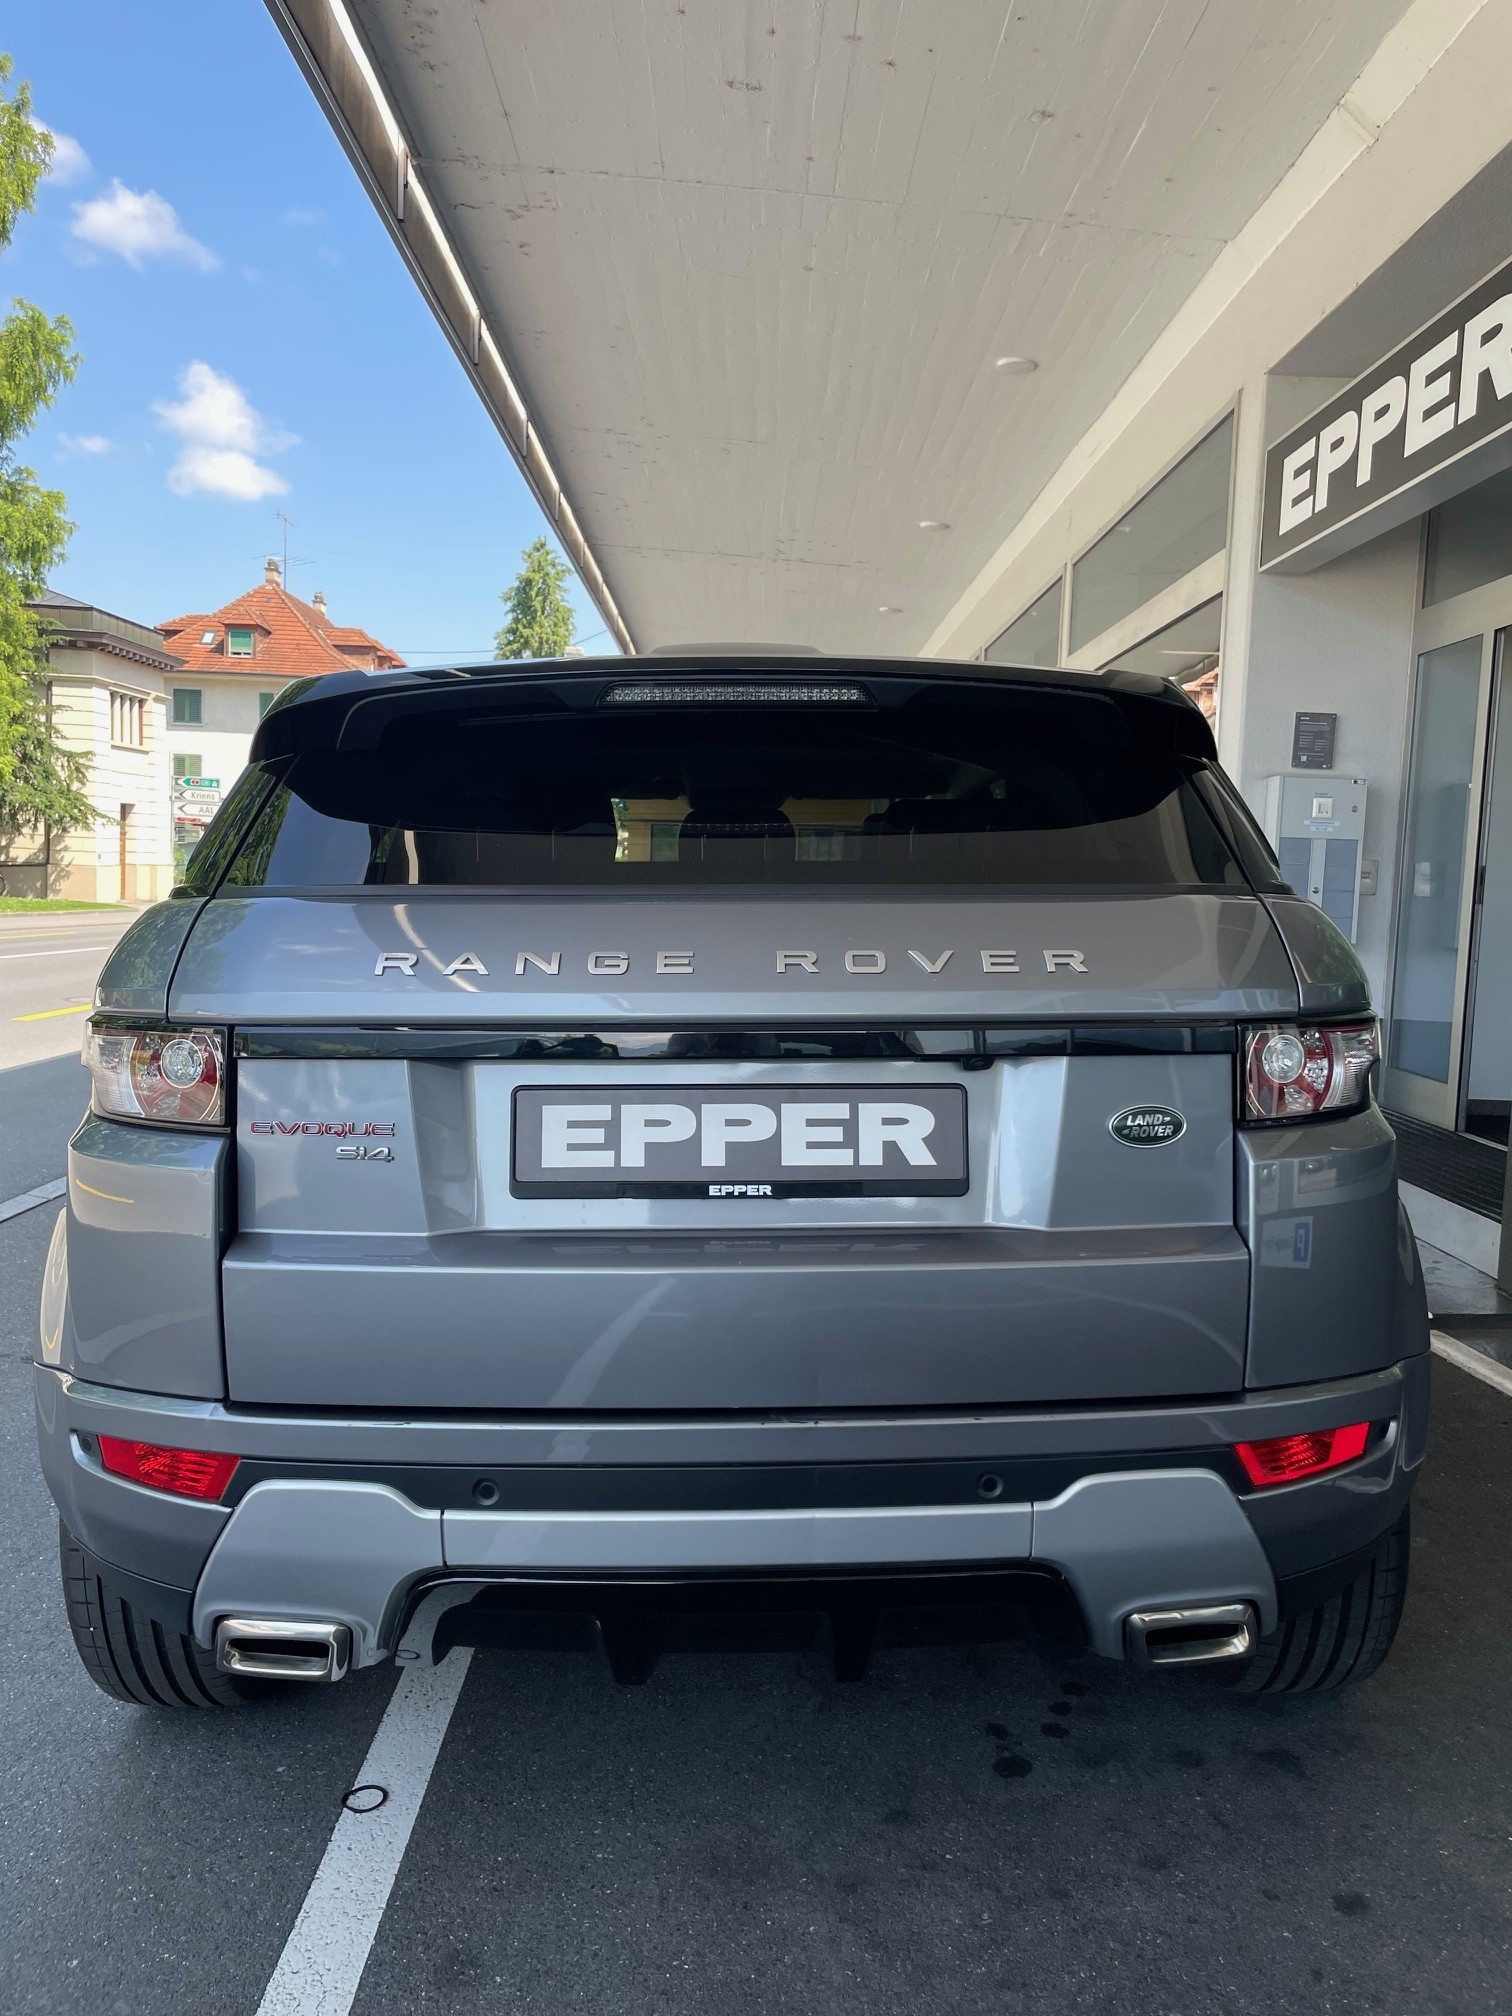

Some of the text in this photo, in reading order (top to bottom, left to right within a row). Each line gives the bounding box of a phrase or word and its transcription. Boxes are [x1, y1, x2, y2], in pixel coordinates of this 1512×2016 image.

[1279, 292, 1512, 536] EPPER
[191, 791, 215, 800] Kriens
[199, 806, 214, 814] AAL
[374, 949, 1089, 977] RANGE ROVER
[1126, 1114, 1163, 1126] LAND
[250, 1121, 395, 1139] EVOQUE
[541, 1102, 937, 1168] EPPER
[1130, 1125, 1174, 1137] ROVER
[708, 1184, 773, 1196] EPPER
